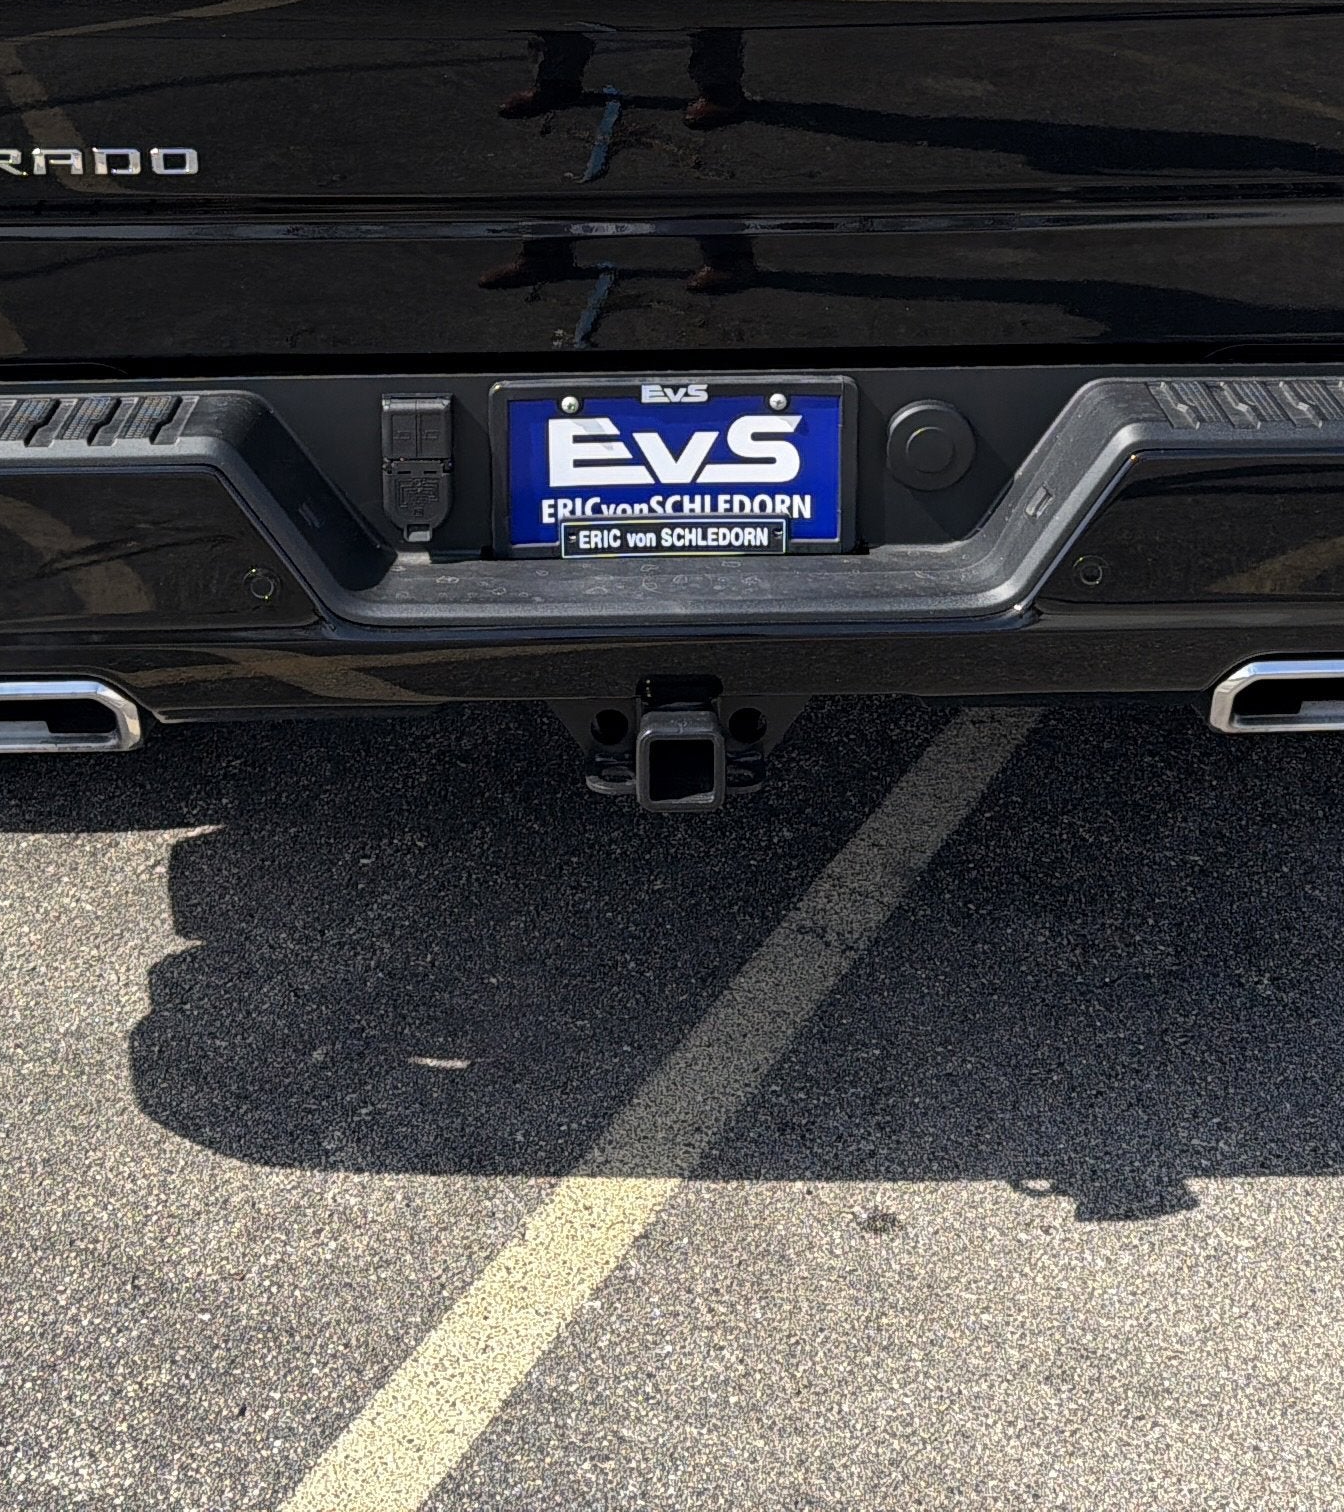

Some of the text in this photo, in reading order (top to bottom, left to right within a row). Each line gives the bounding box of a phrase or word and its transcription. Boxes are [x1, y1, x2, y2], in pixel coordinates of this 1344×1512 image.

[579, 527, 769, 549] ERIC von SCHLEDORN
